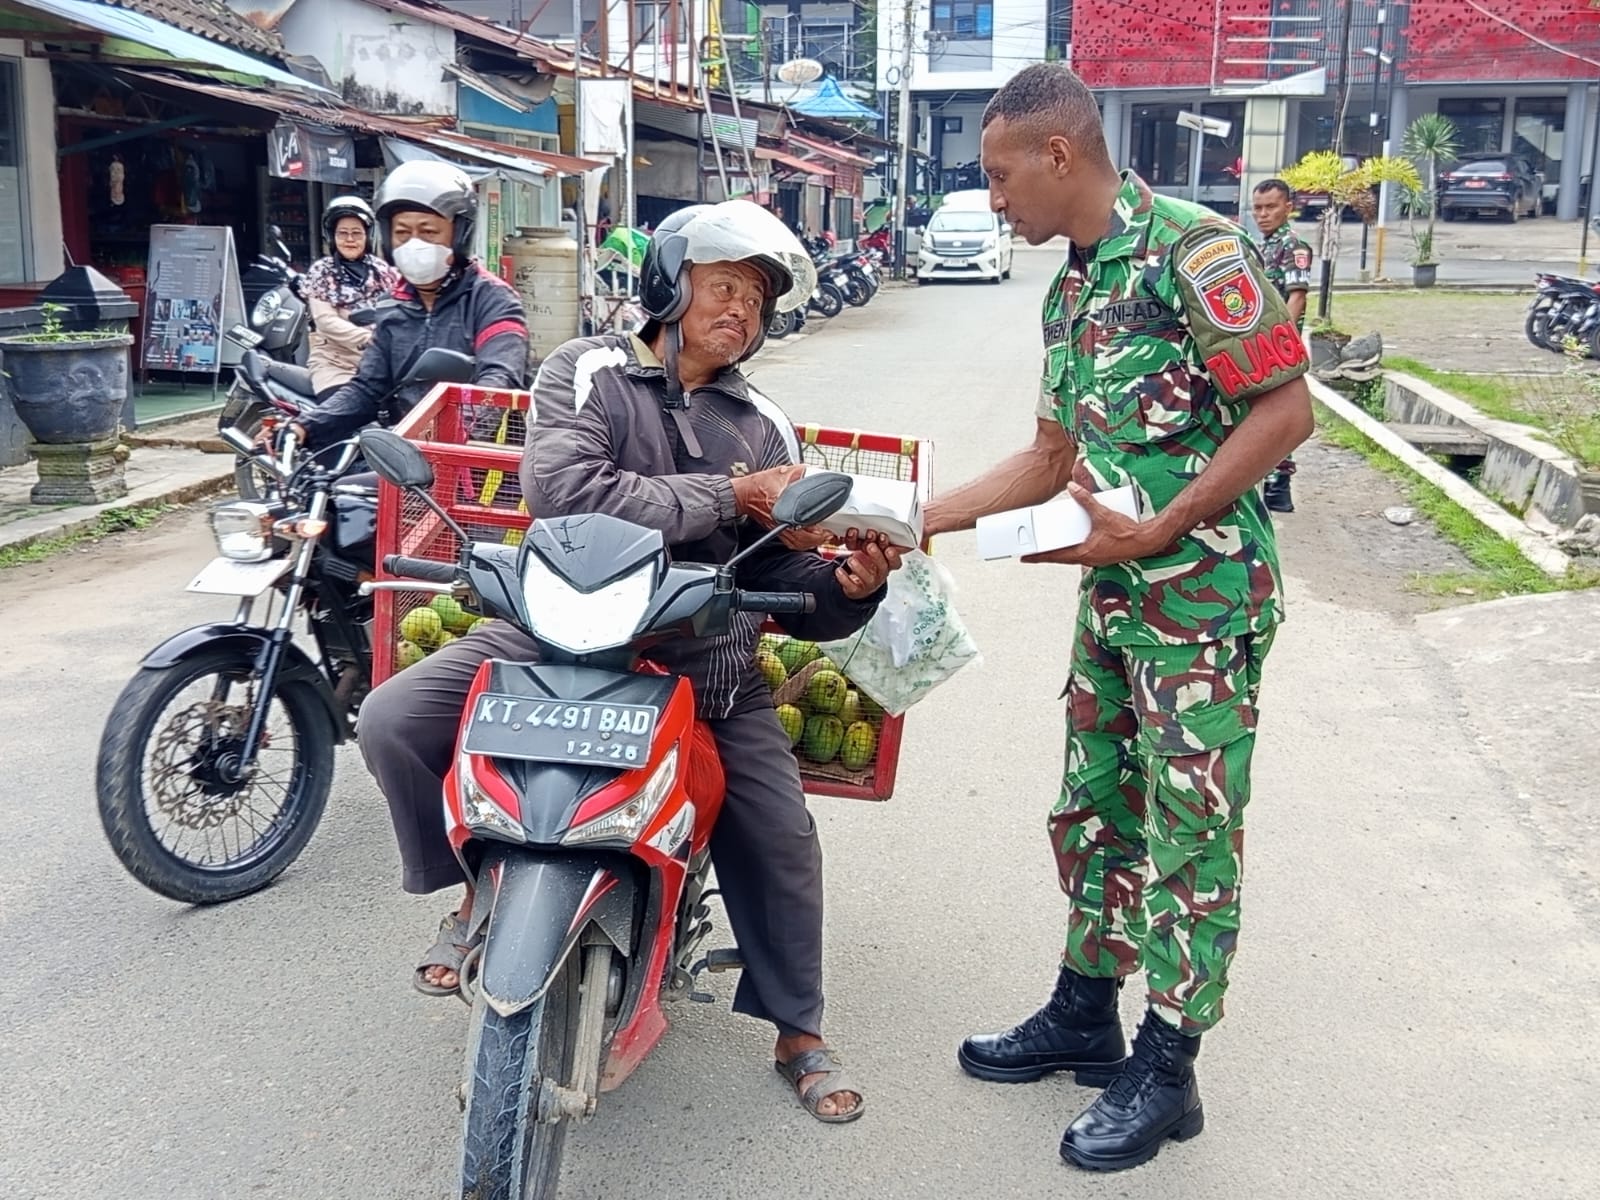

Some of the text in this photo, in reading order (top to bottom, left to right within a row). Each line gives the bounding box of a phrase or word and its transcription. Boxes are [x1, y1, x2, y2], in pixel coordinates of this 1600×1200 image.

[1103, 300, 1162, 324] TNI-AD
[1206, 320, 1305, 395] TA JAGA
[478, 699, 650, 735] KT 4491 BAD
